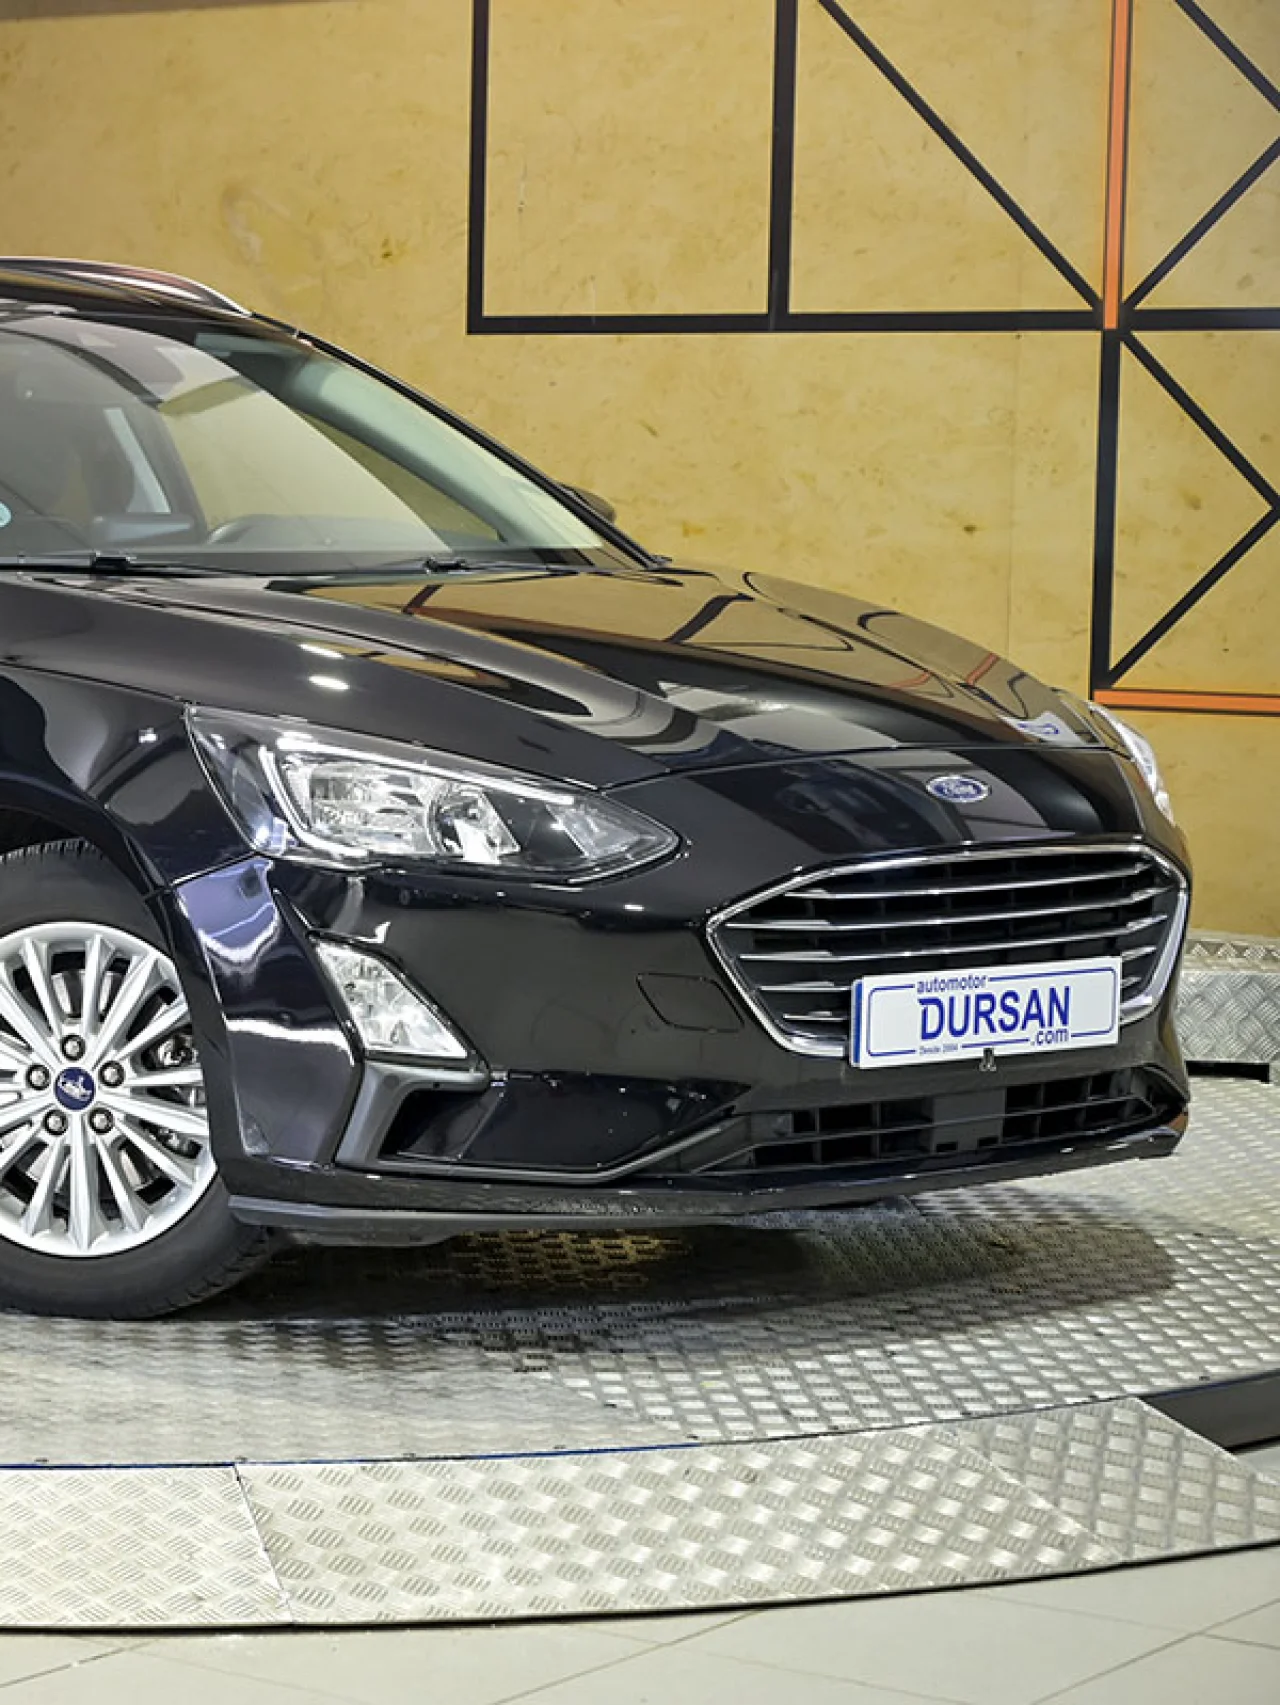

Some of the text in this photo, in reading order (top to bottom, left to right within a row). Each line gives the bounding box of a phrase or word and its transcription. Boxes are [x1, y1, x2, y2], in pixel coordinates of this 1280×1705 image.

[916, 974, 988, 994] automotor
[917, 985, 1070, 1041] DURSAN
[1030, 1027, 1068, 1047] .com
